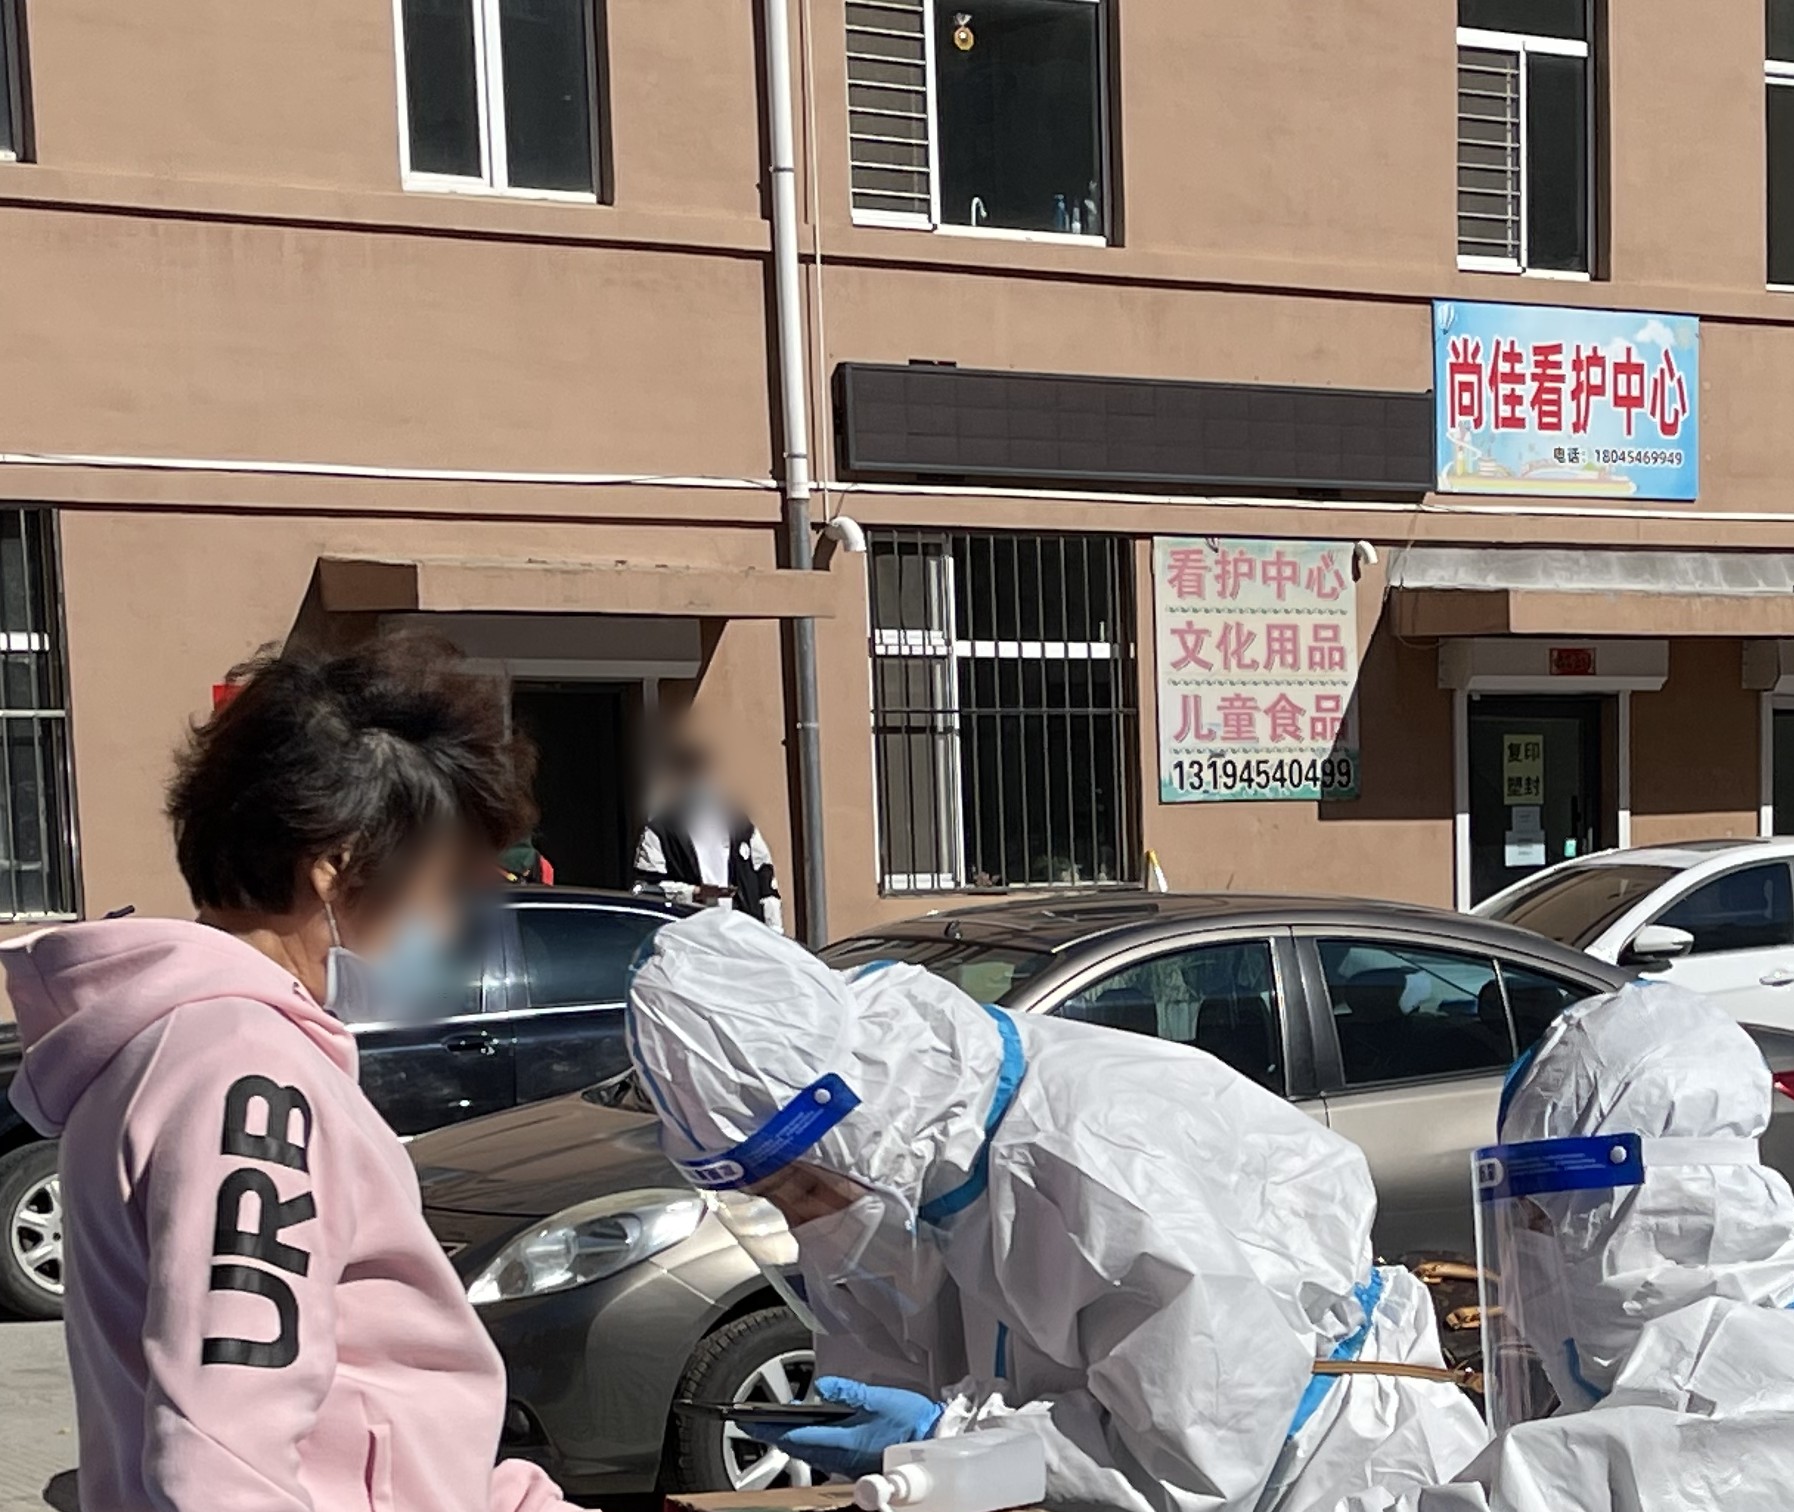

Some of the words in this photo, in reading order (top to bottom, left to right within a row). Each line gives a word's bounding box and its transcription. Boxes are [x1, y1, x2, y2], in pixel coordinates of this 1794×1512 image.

[1448, 337, 1688, 437] 尚佳看护中心
[1167, 548, 1348, 601] 看护中心
[1169, 620, 1348, 672] 文化用品
[1172, 692, 1347, 743] 儿童食品
[1172, 758, 1352, 791] 13194540499
[1507, 742, 1541, 764] 复印
[1506, 776, 1541, 797] 塑封
